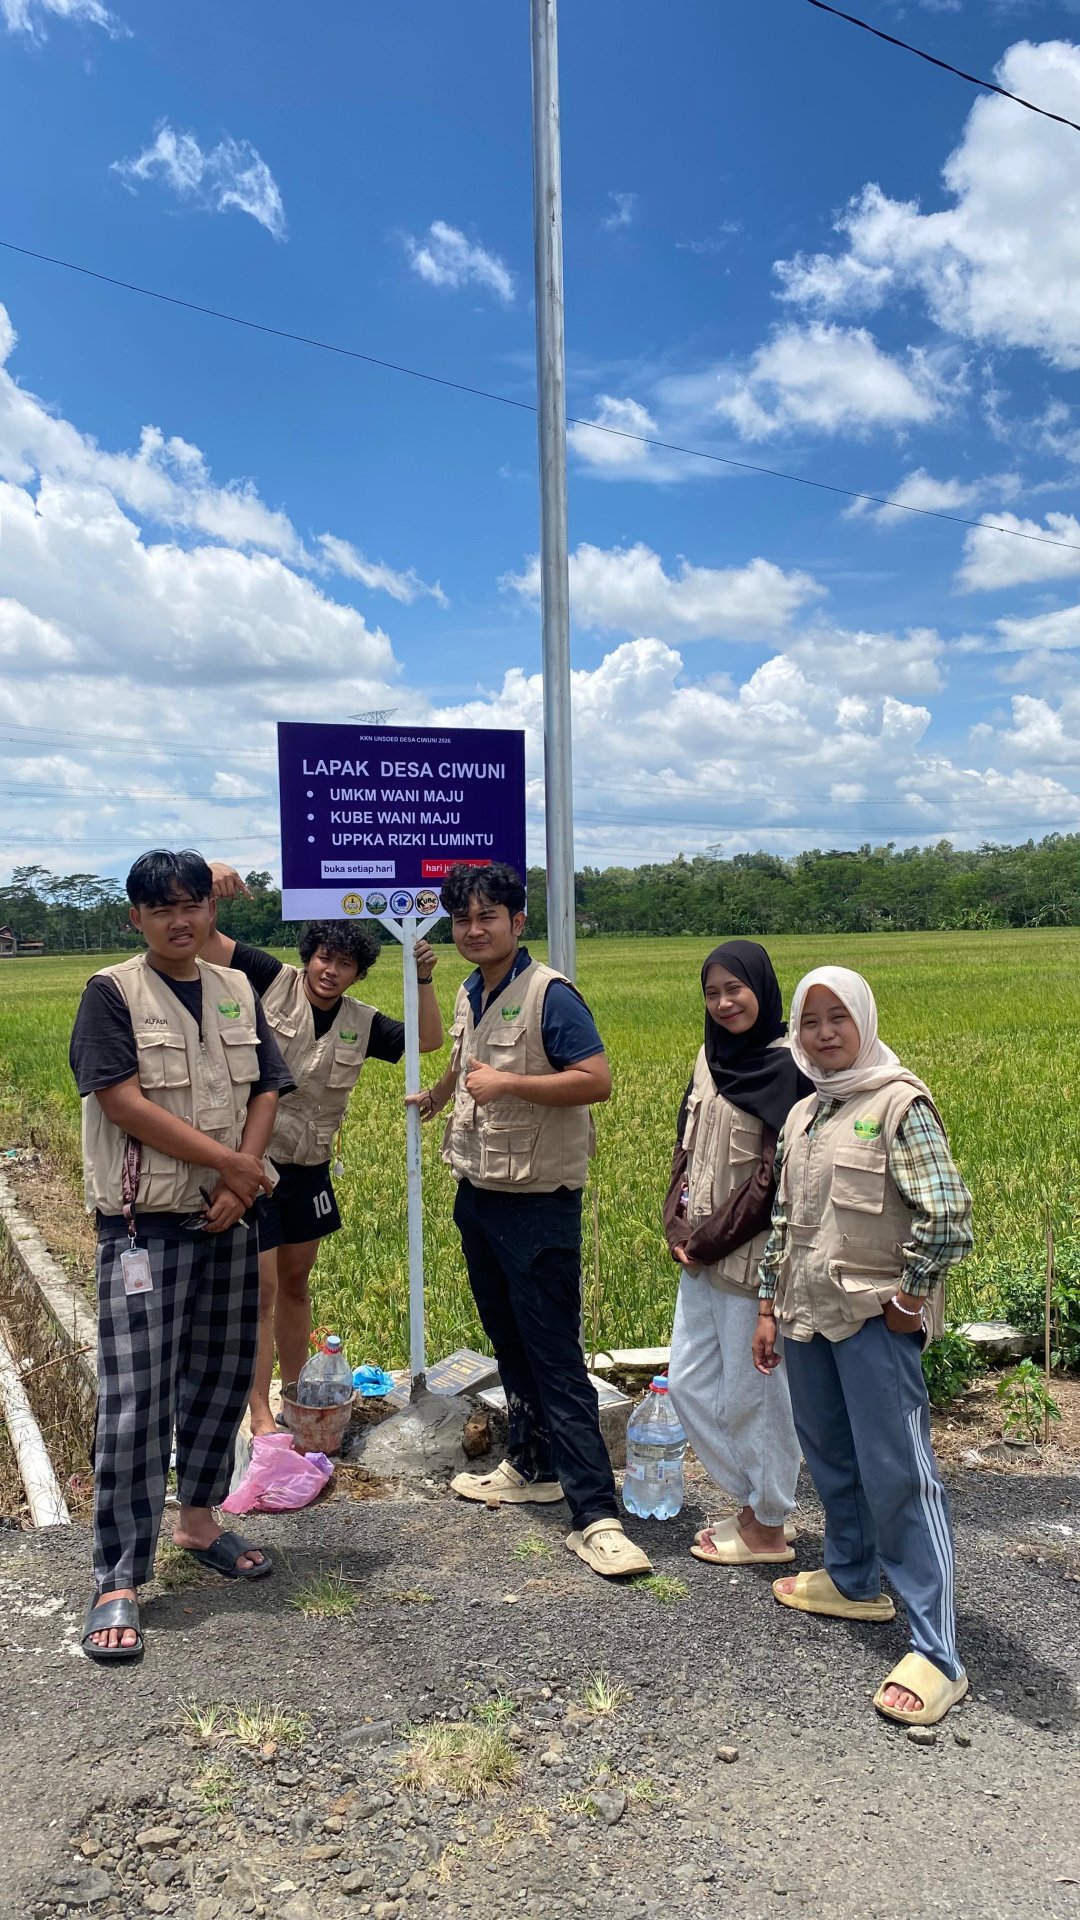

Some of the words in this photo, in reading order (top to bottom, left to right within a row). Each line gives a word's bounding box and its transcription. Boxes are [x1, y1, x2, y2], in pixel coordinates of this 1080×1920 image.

[374, 735, 399, 743] UNSOED
[302, 759, 370, 777] LAPAK
[380, 761, 434, 778] DESA
[438, 762, 506, 779] CIWUNI
[330, 788, 377, 801] UMKM
[380, 789, 420, 802] WANI
[423, 790, 464, 803] MAJU
[330, 811, 374, 824] KUBE
[377, 811, 416, 824] WANI
[420, 812, 460, 825] MAJU
[331, 833, 385, 846] UPPKA
[388, 833, 426, 846] RIZKI
[430, 833, 494, 846] LUMINTU
[323, 864, 346, 873] buka
[347, 864, 374, 875] setiap
[375, 864, 393, 873] hari
[425, 864, 443, 872] hari
[312, 1190, 332, 1219] 10
